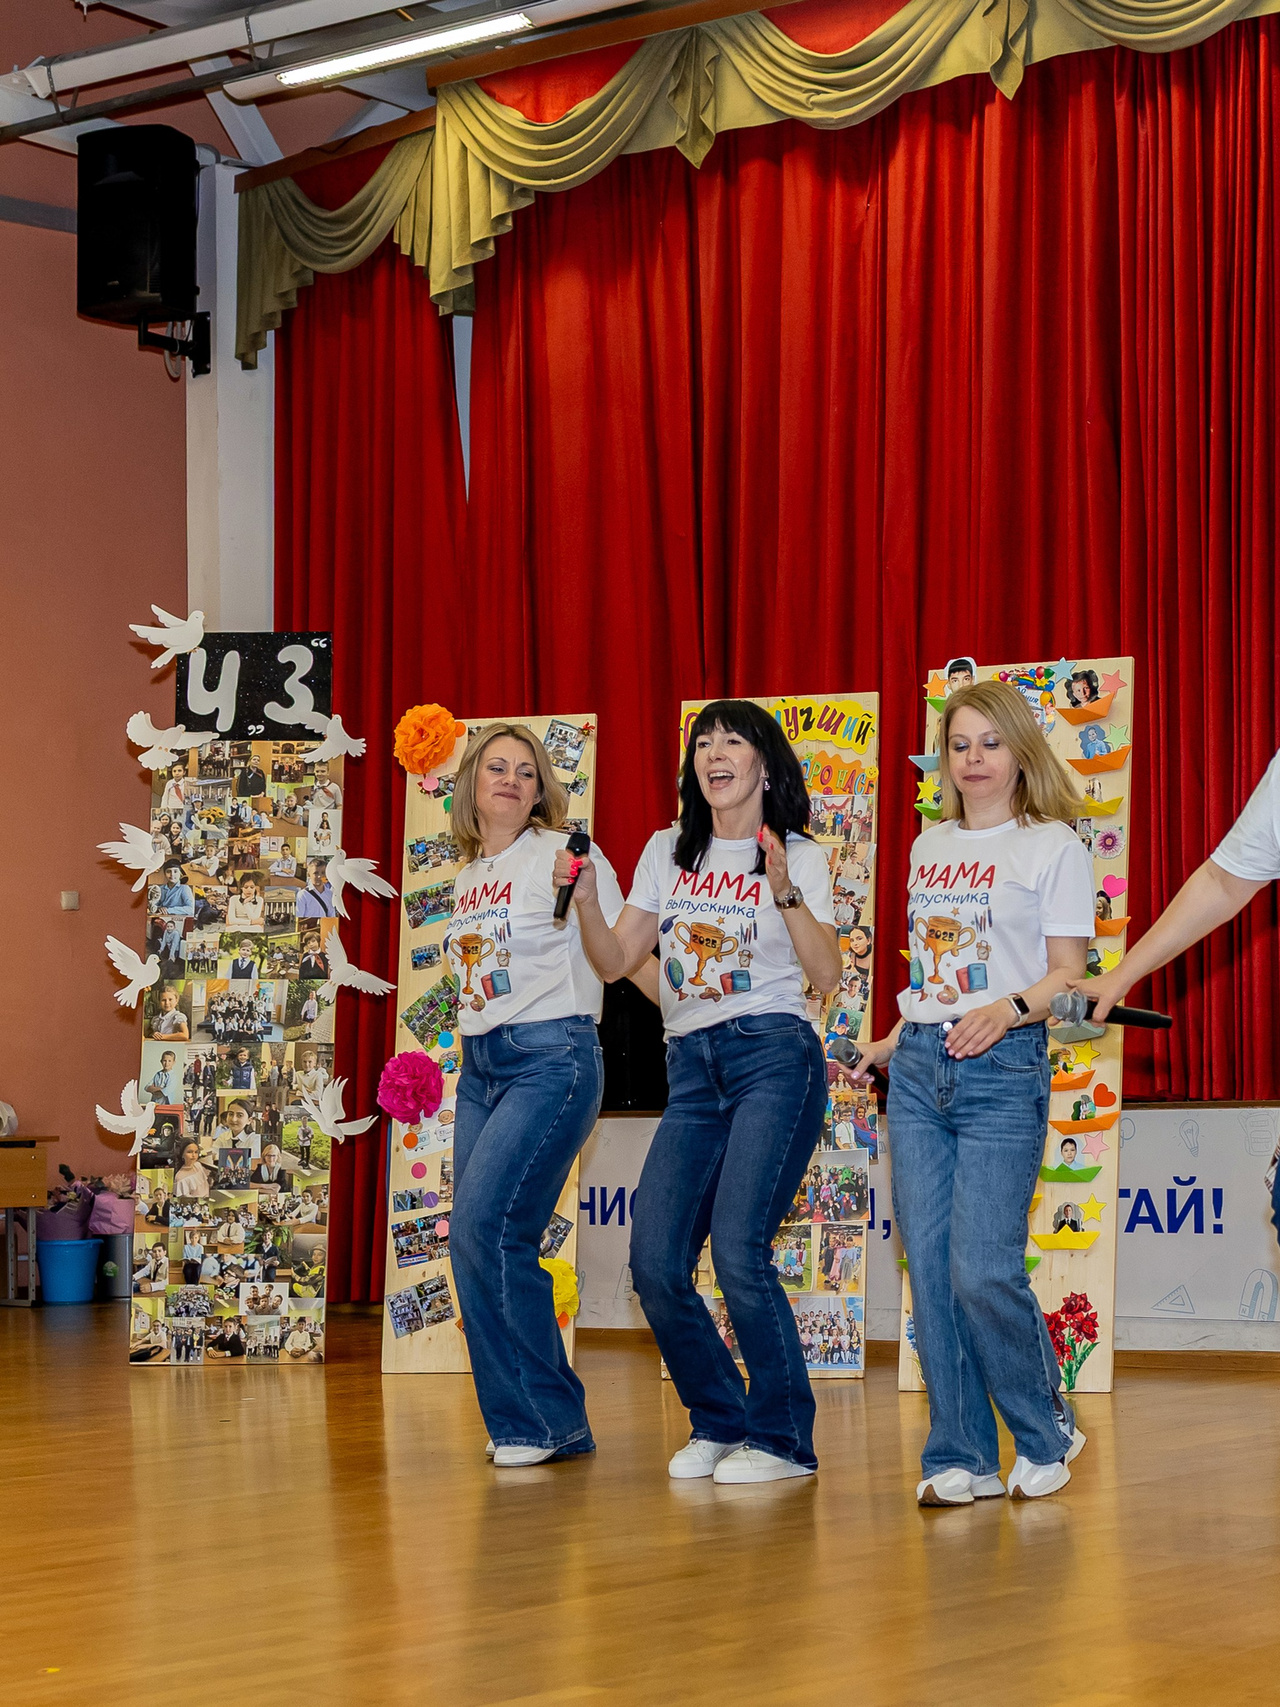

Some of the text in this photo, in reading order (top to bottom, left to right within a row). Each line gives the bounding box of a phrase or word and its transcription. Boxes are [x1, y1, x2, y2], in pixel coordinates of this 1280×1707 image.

[672, 869, 761, 906] МАМА
[909, 861, 996, 889] МАМА
[451, 879, 512, 918] МАМА
[692, 934, 718, 949] 2025
[928, 928, 954, 942] 2025
